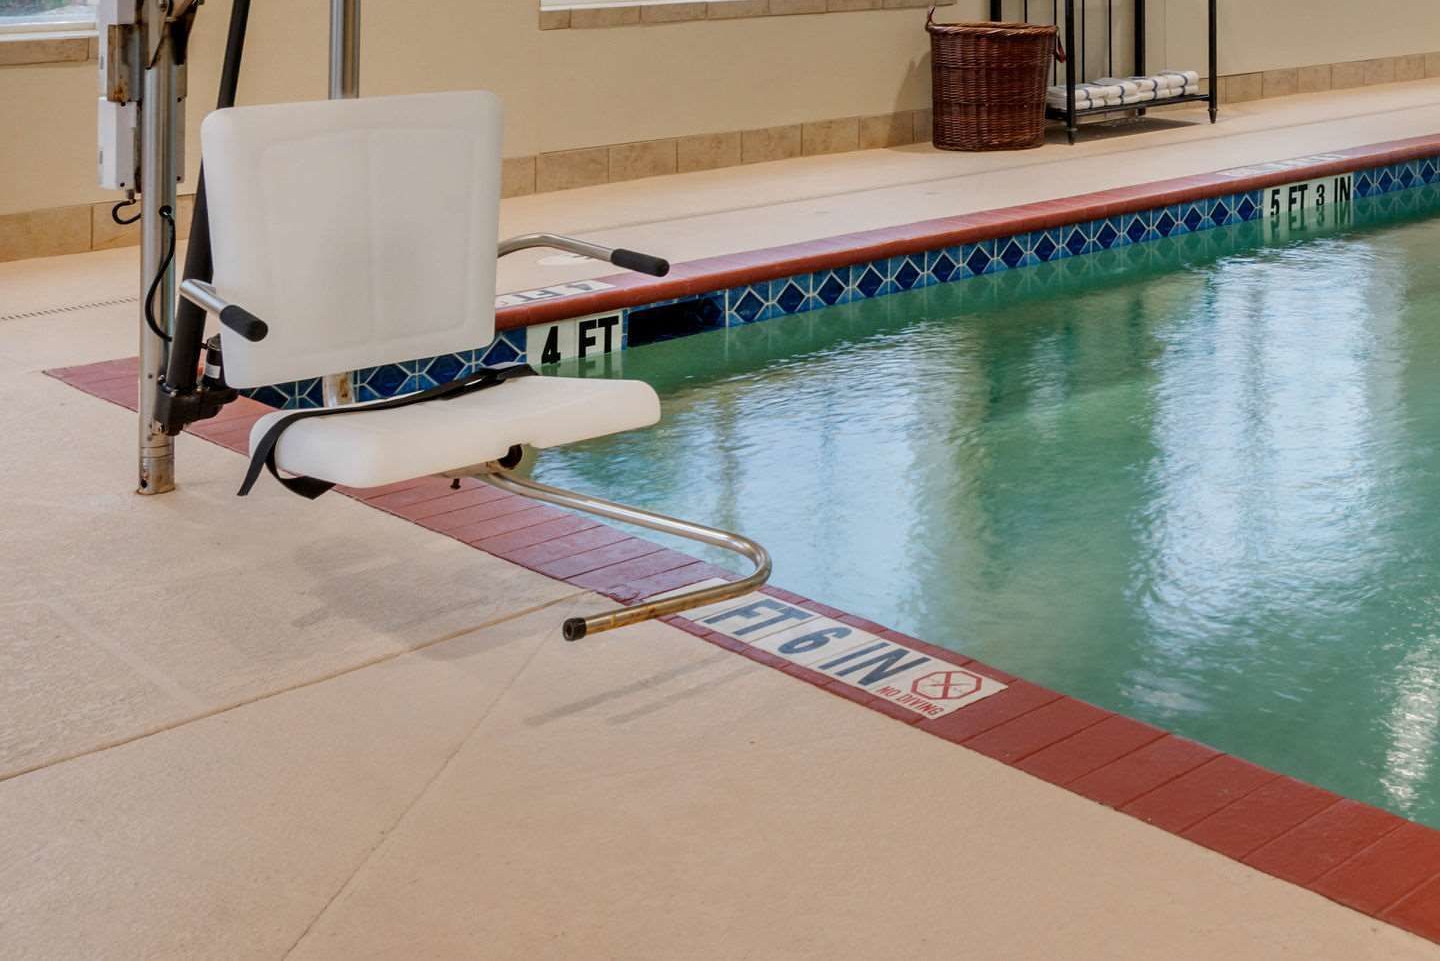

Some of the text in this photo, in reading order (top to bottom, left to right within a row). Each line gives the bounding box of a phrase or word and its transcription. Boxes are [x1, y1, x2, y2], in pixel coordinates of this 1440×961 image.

[1270, 176, 1352, 215] 5 FT 3 IN
[541, 315, 619, 364] 4 FT
[703, 598, 931, 686] FT 6 IN
[877, 685, 945, 716] NO DIVING
